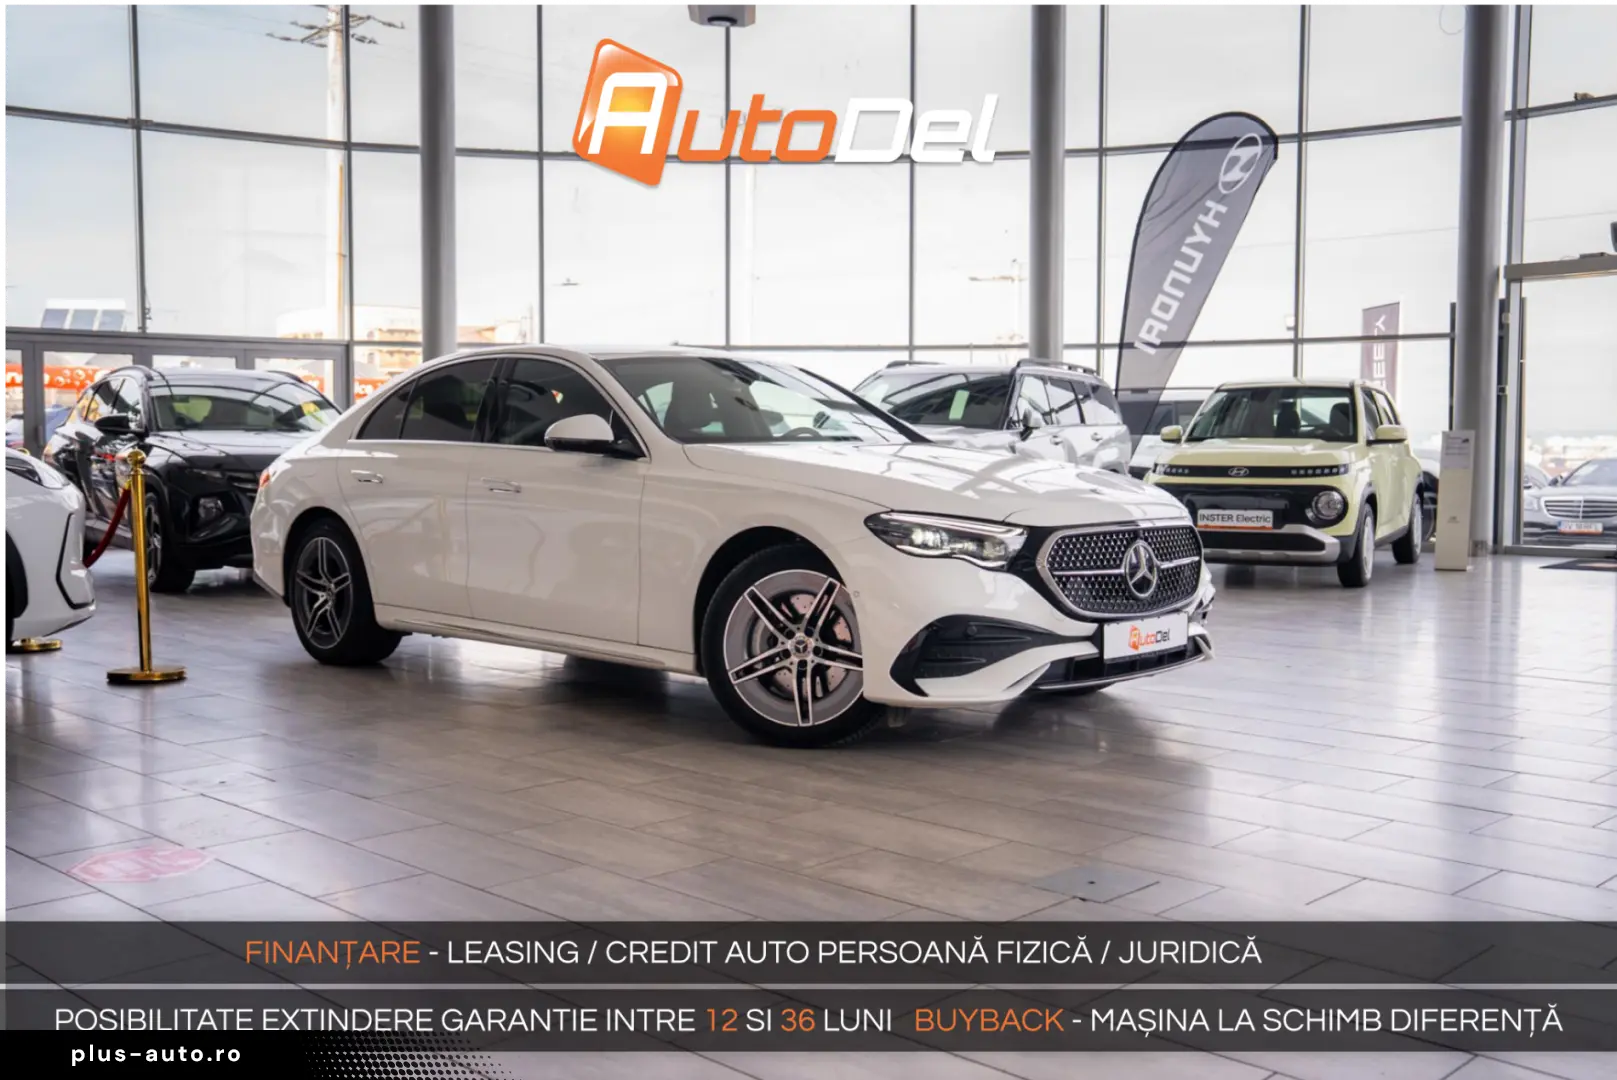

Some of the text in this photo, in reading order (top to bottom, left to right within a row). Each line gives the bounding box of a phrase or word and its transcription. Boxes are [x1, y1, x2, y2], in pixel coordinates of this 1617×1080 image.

[1199, 513, 1271, 523] INSTER Electric
[1129, 626, 1171, 648] AutoDel
